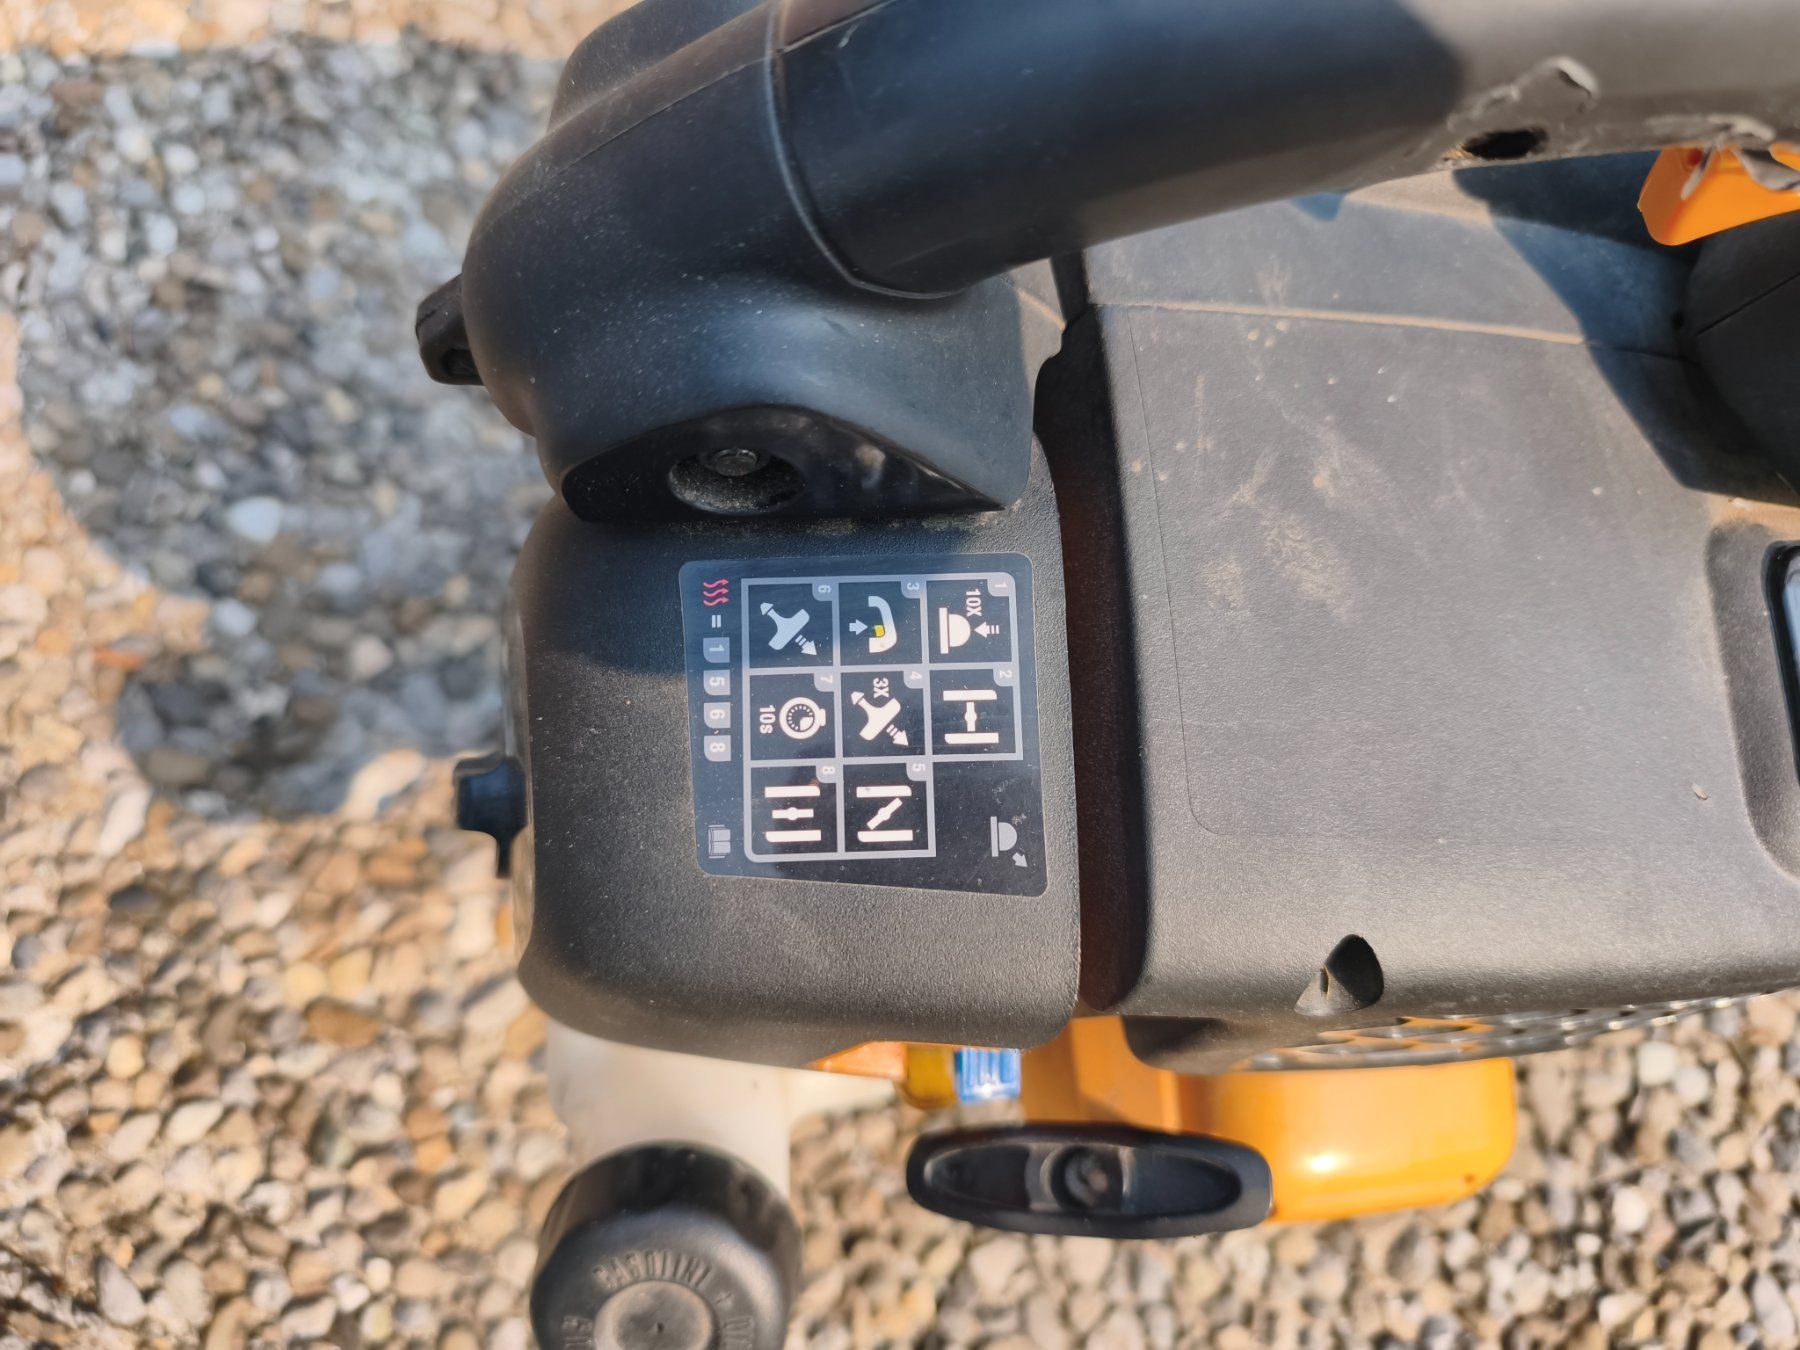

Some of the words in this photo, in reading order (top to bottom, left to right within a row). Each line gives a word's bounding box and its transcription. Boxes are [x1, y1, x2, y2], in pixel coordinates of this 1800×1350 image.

[818, 584, 831, 593] 6
[906, 582, 920, 590] 3
[965, 588, 982, 617] 10X
[709, 644, 725, 652] 1
[820, 675, 834, 683] 7
[910, 671, 923, 680] 4
[999, 670, 1013, 679] 2
[709, 676, 725, 686] 5
[873, 677, 890, 698] 3X
[709, 708, 726, 719] 6
[759, 704, 776, 734] 10s
[710, 742, 726, 752] 8
[822, 766, 836, 774] 8
[912, 763, 926, 772] 5
